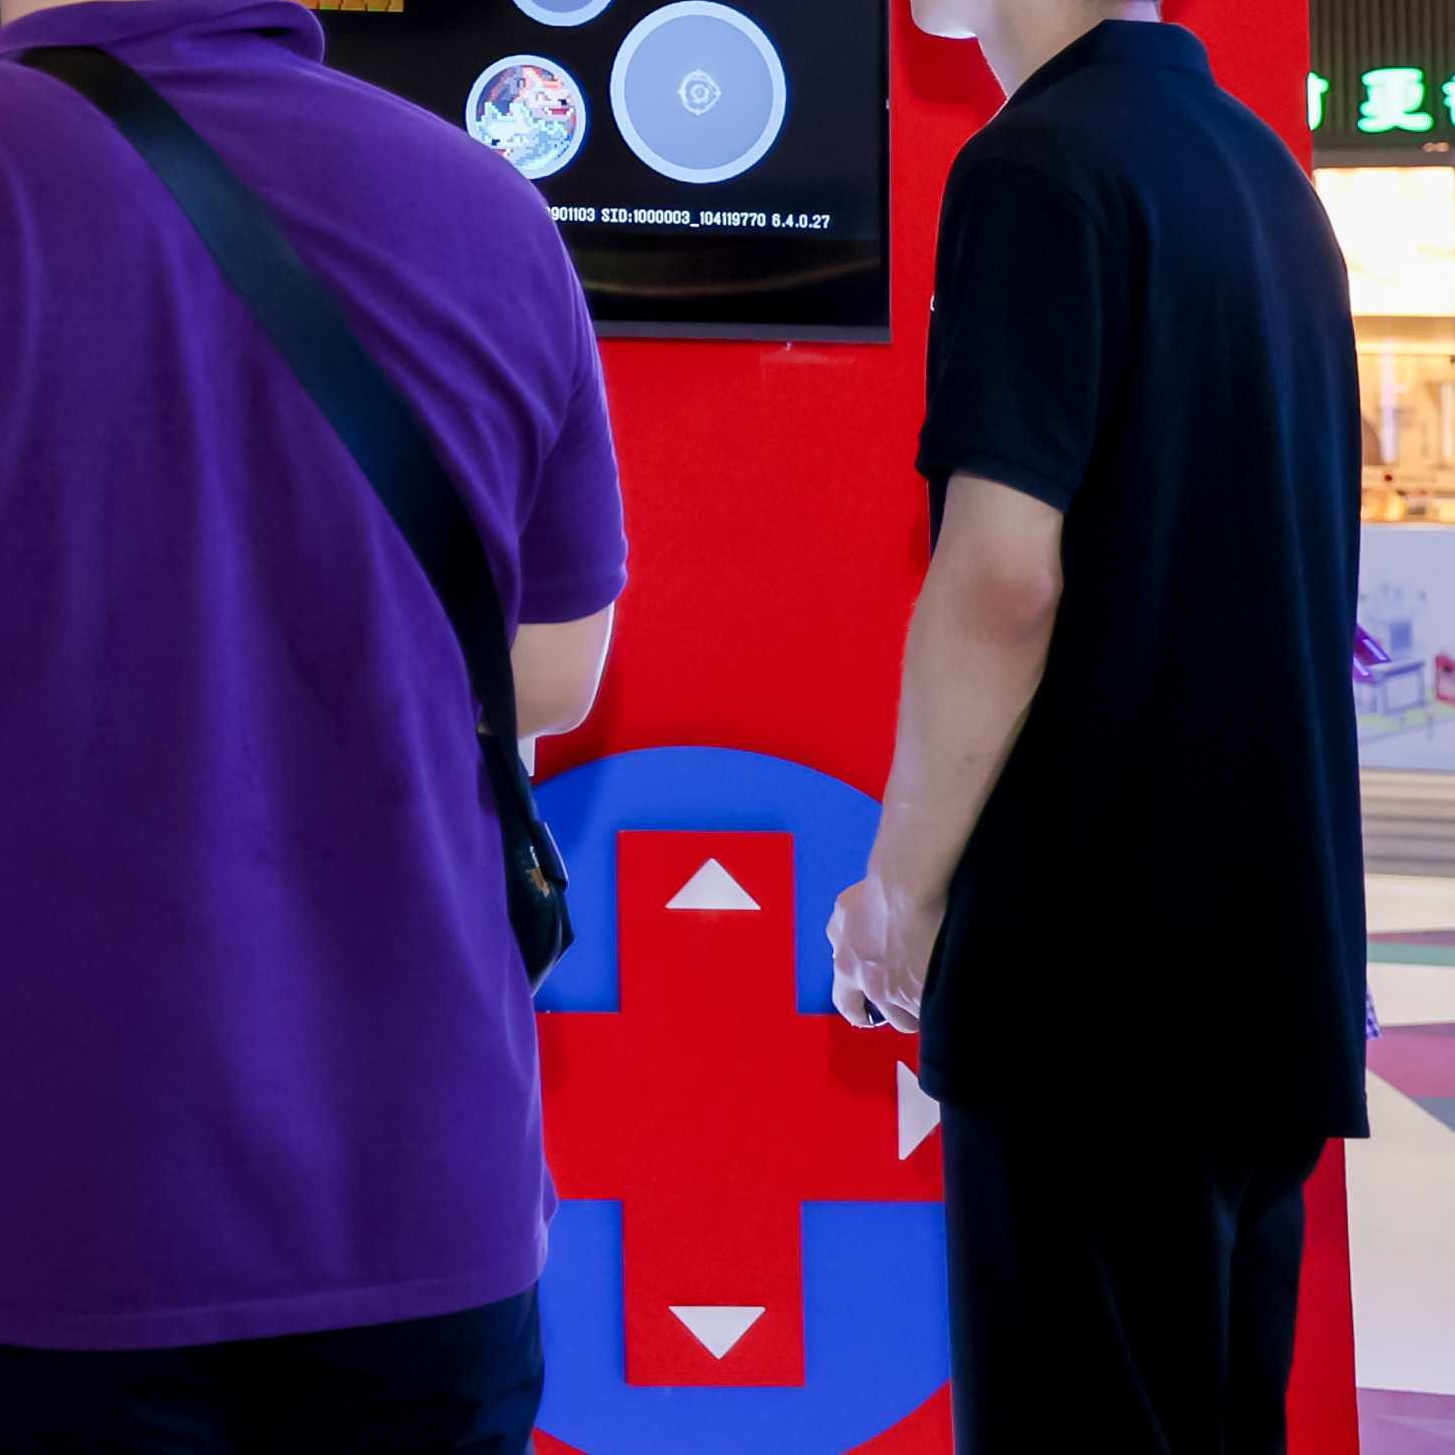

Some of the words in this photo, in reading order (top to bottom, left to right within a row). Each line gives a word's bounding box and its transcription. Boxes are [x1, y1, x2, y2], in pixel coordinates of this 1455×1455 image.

[546, 206, 595, 222] 901103
[601, 208, 766, 227] SID:1000003_104119770
[772, 214, 830, 229] 6.4.0.27
